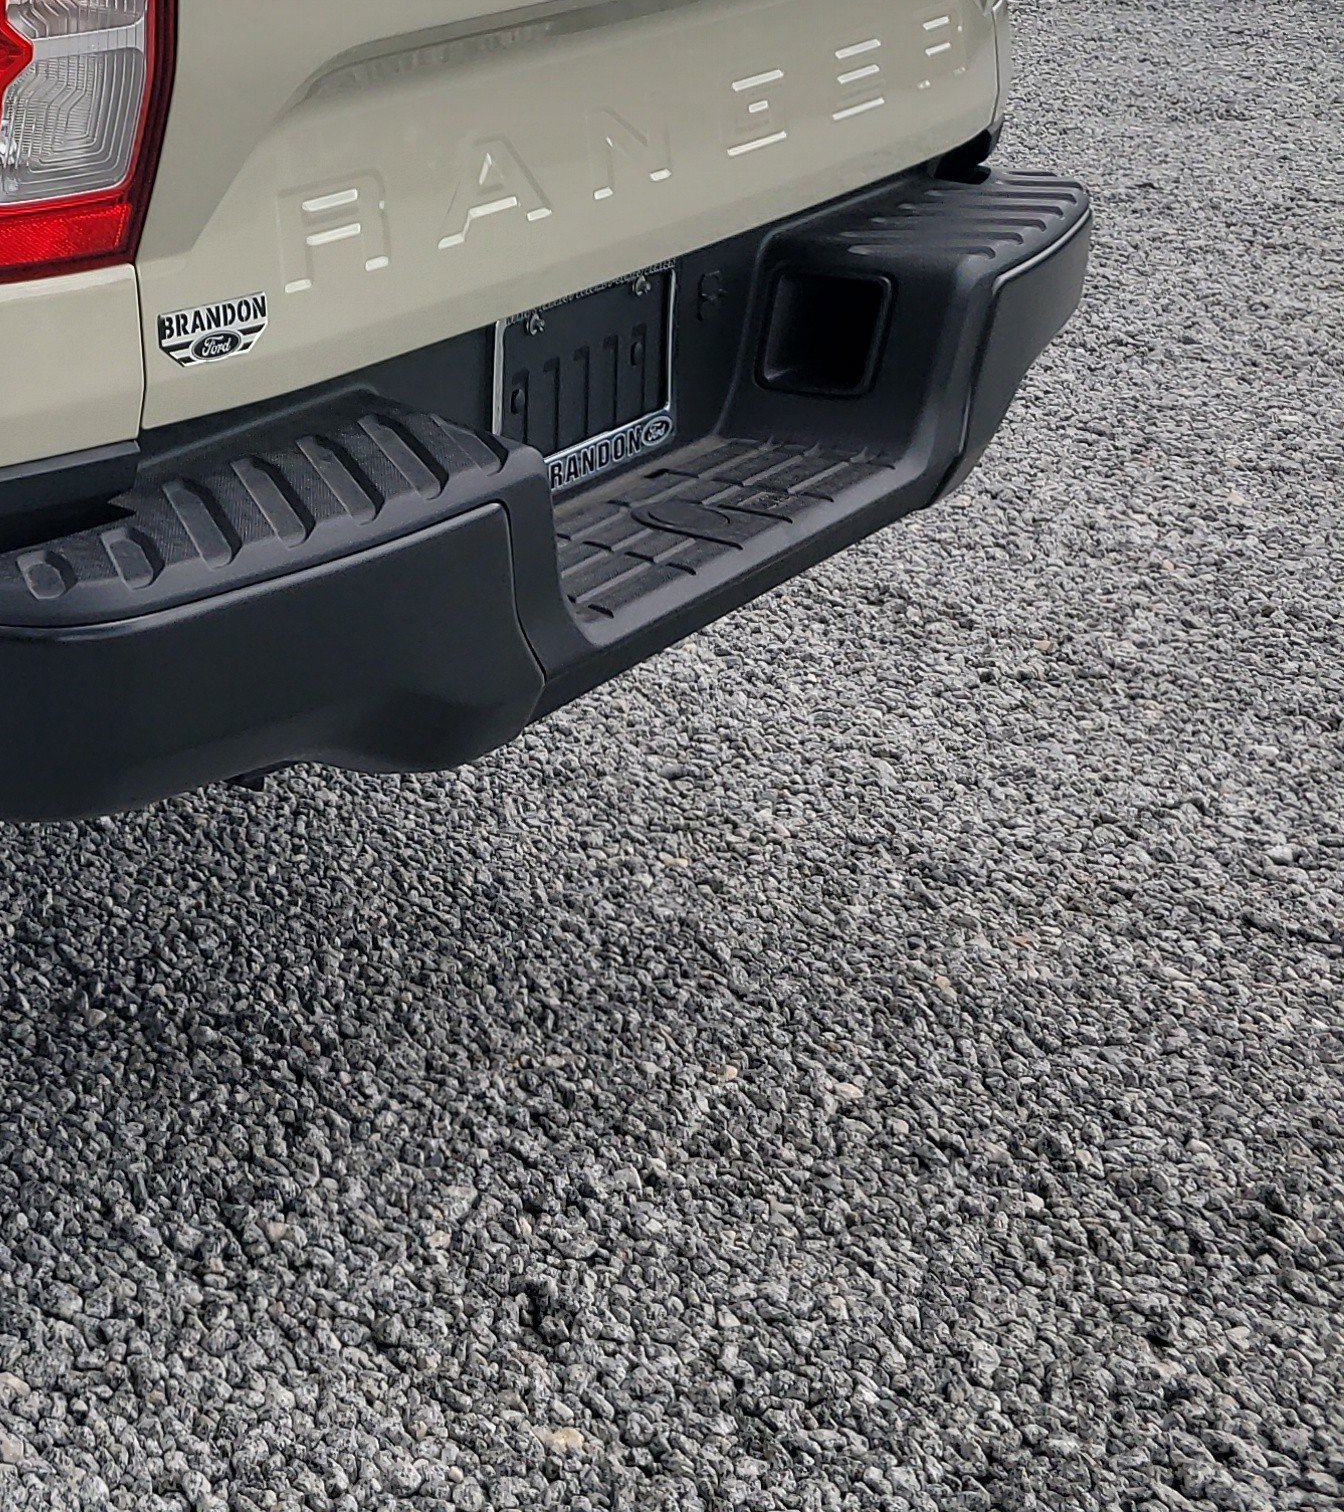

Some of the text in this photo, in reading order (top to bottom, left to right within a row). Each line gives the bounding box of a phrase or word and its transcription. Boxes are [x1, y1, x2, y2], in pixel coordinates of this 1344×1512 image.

[161, 295, 267, 339] BRANDON
[201, 334, 232, 357] Ford
[548, 423, 643, 491] RANDON
